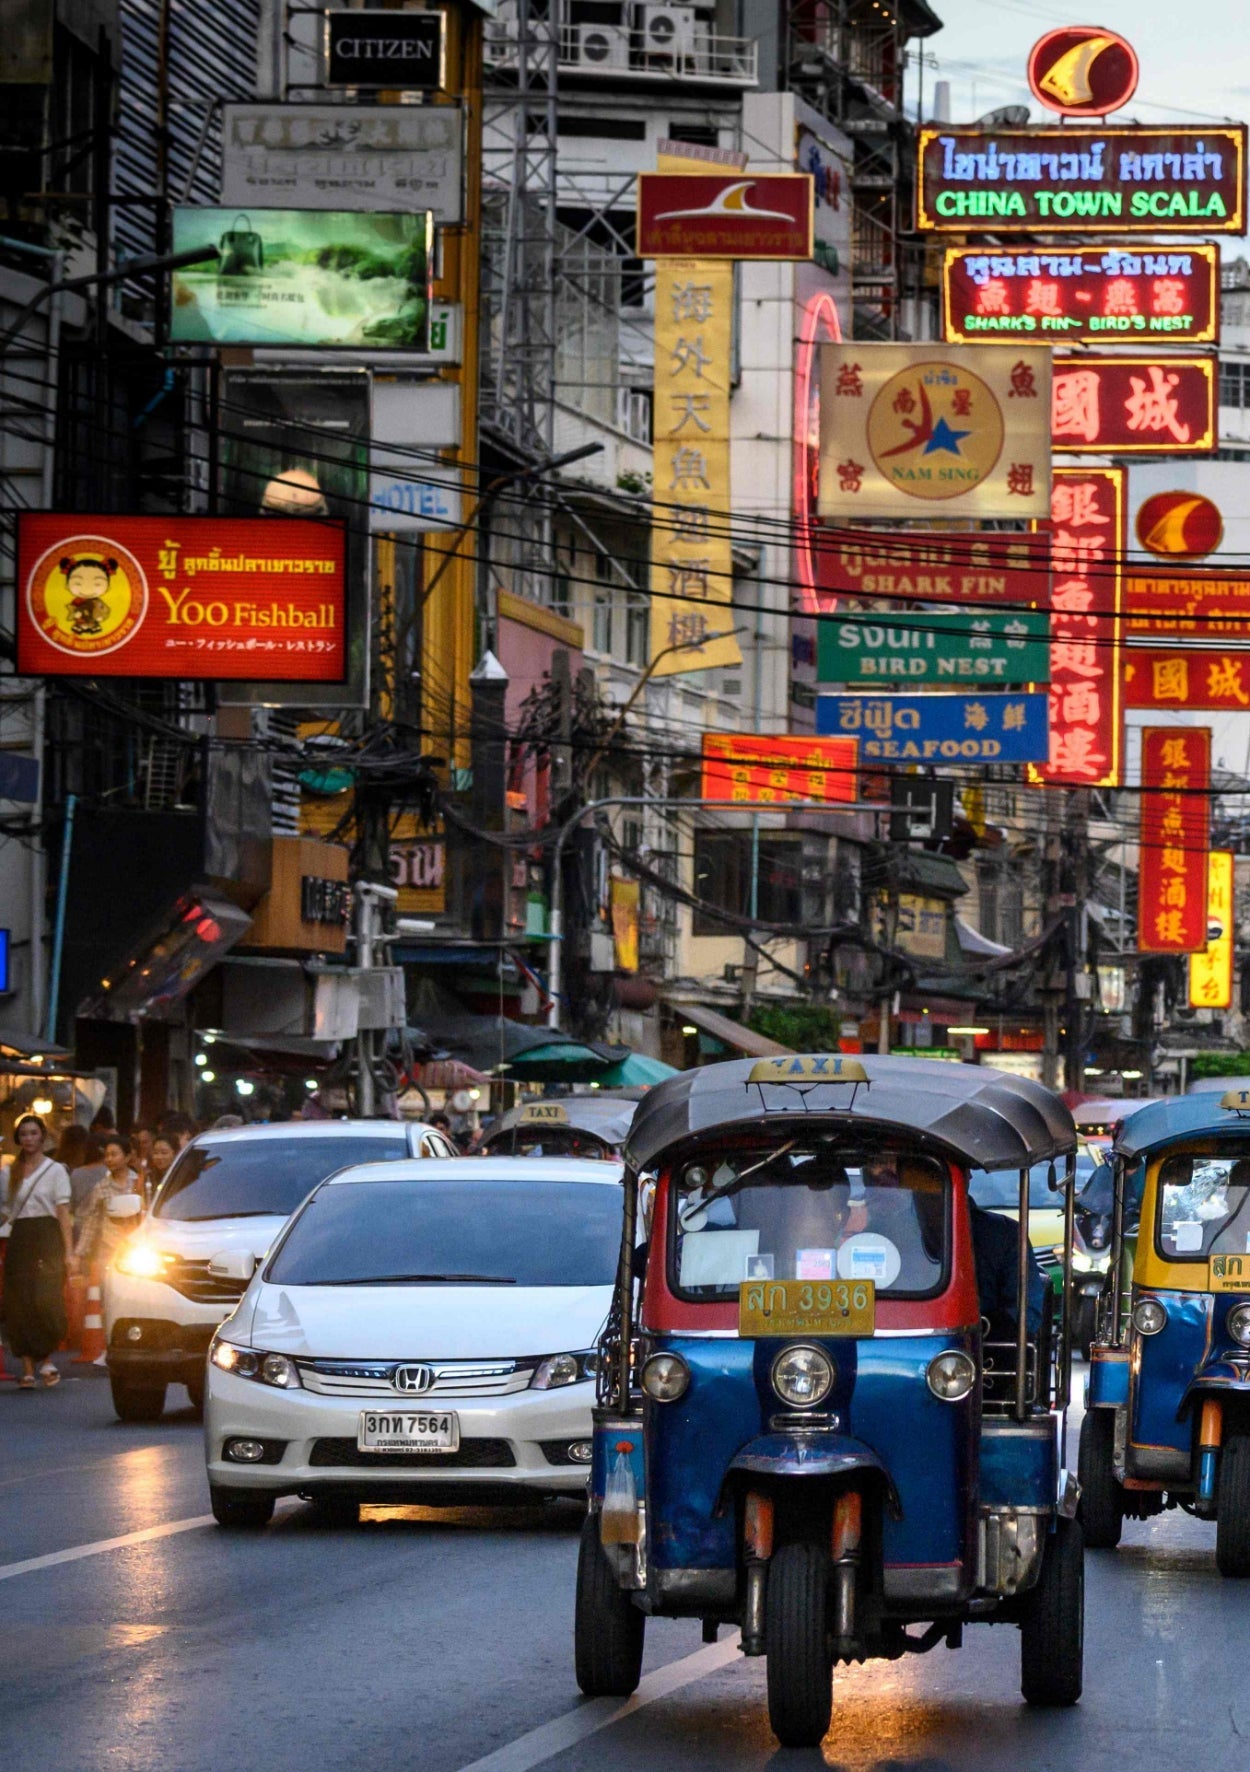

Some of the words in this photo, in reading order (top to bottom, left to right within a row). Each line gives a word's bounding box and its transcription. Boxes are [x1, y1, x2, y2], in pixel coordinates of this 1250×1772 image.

[336, 38, 433, 59] CITIZEN
[936, 191, 1026, 216] CHINA
[1034, 191, 1122, 217] TOWN
[1130, 191, 1227, 216] SCALA
[964, 315, 1036, 331] SHARK'S
[1089, 316, 1146, 331] BIRD'S
[1150, 317, 1193, 331] NEST
[892, 467, 933, 481] NAM
[938, 467, 980, 481] SING
[373, 484, 448, 514] HOTEL
[862, 575, 953, 595] SHARK
[960, 576, 1006, 595] FIN
[233, 603, 336, 628] Fishball
[860, 657, 927, 676] BIRD
[937, 657, 1008, 676] NEST
[865, 740, 1001, 758] SEAFOOD
[771, 1058, 843, 1074] TAXI
[529, 1106, 559, 1117] TAXI
[800, 1285, 867, 1311] 3936
[407, 1417, 449, 1434] 7564
